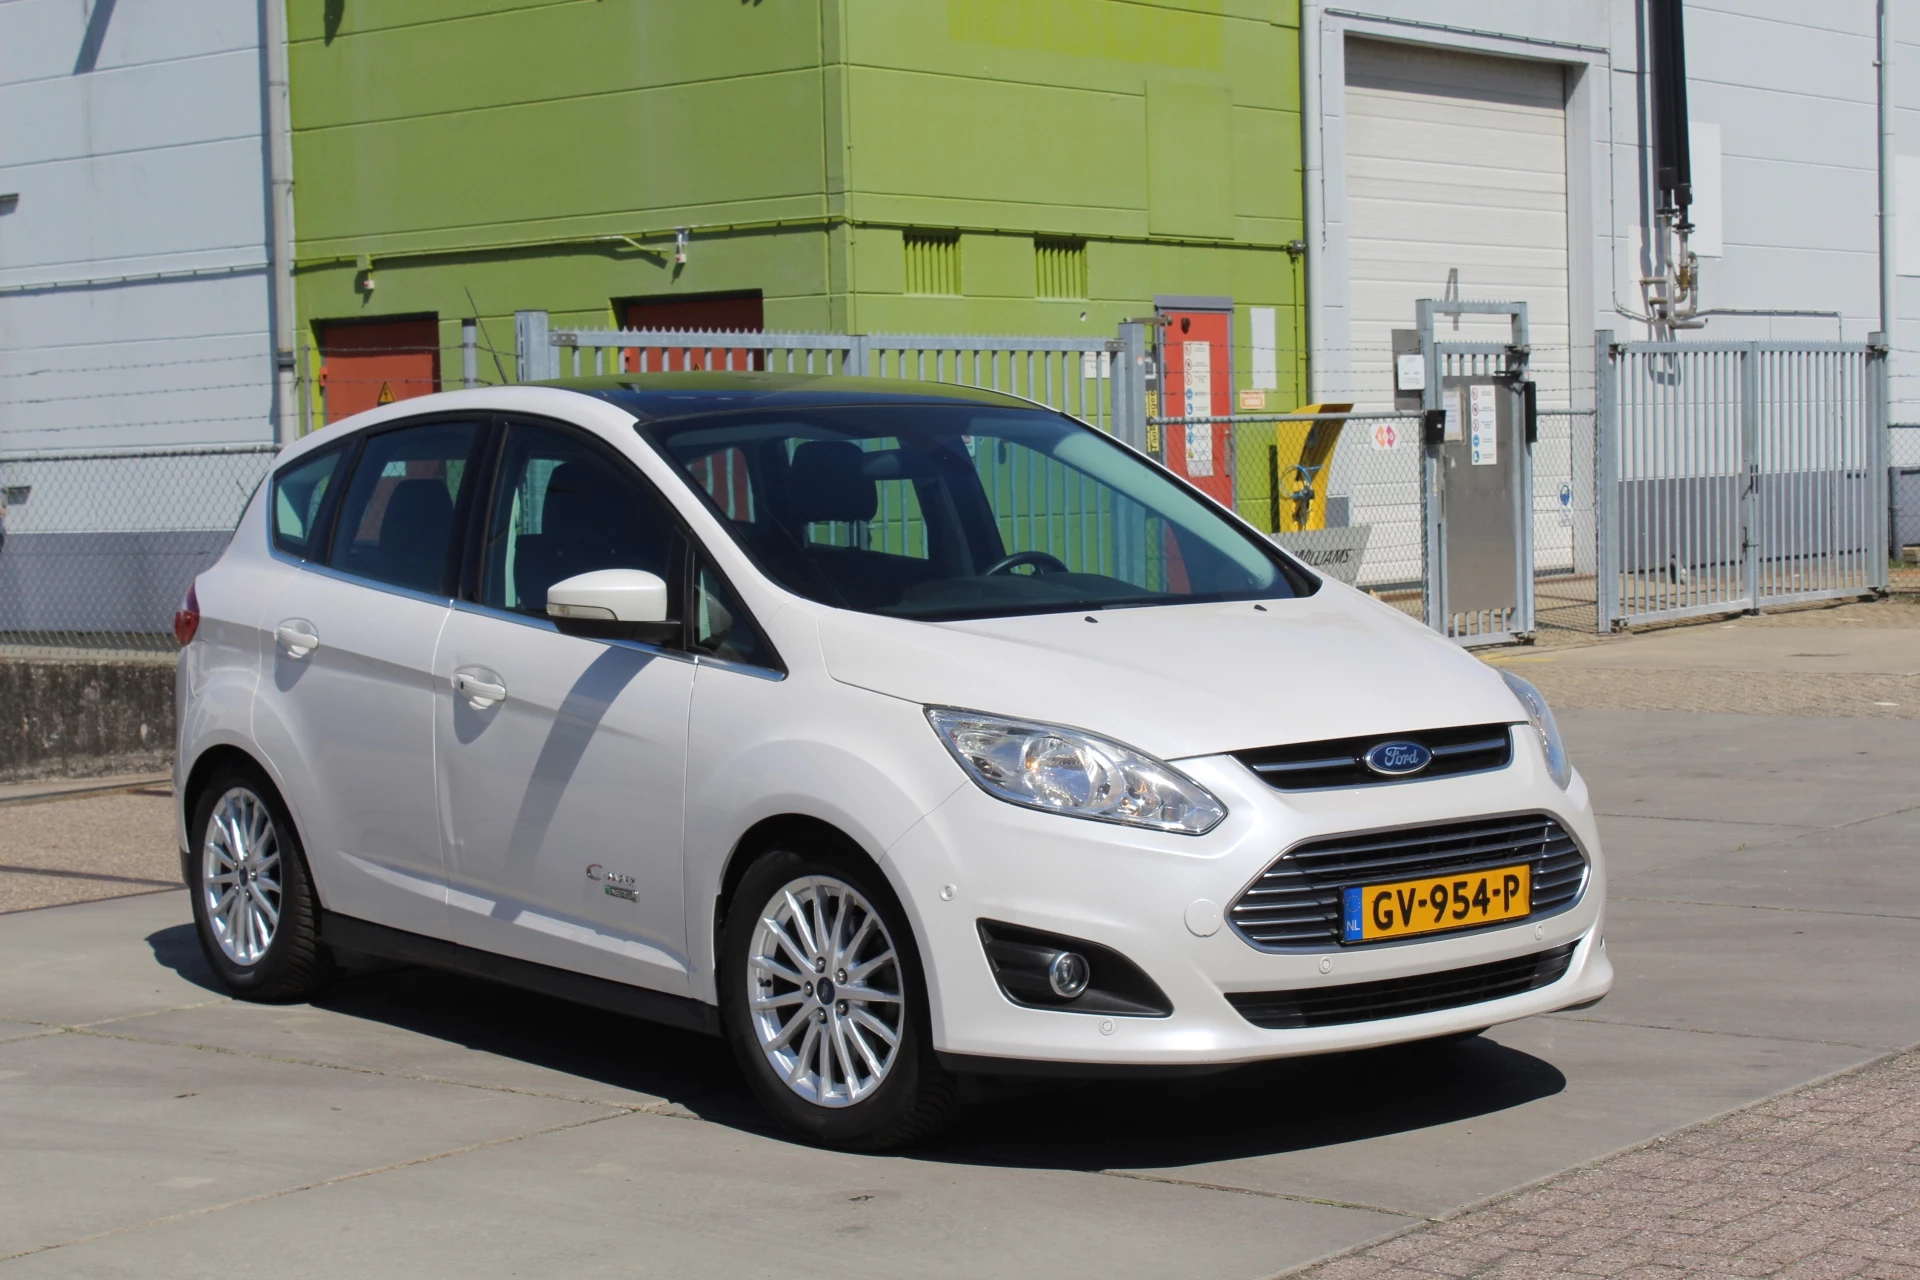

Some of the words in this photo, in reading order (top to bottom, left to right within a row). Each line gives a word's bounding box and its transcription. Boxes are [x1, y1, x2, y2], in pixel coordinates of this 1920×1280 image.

[1443, 268, 1462, 331] 4
[1384, 746, 1418, 767] Ford
[1372, 874, 1520, 931] GV-954-P
[1346, 919, 1361, 932] NL
